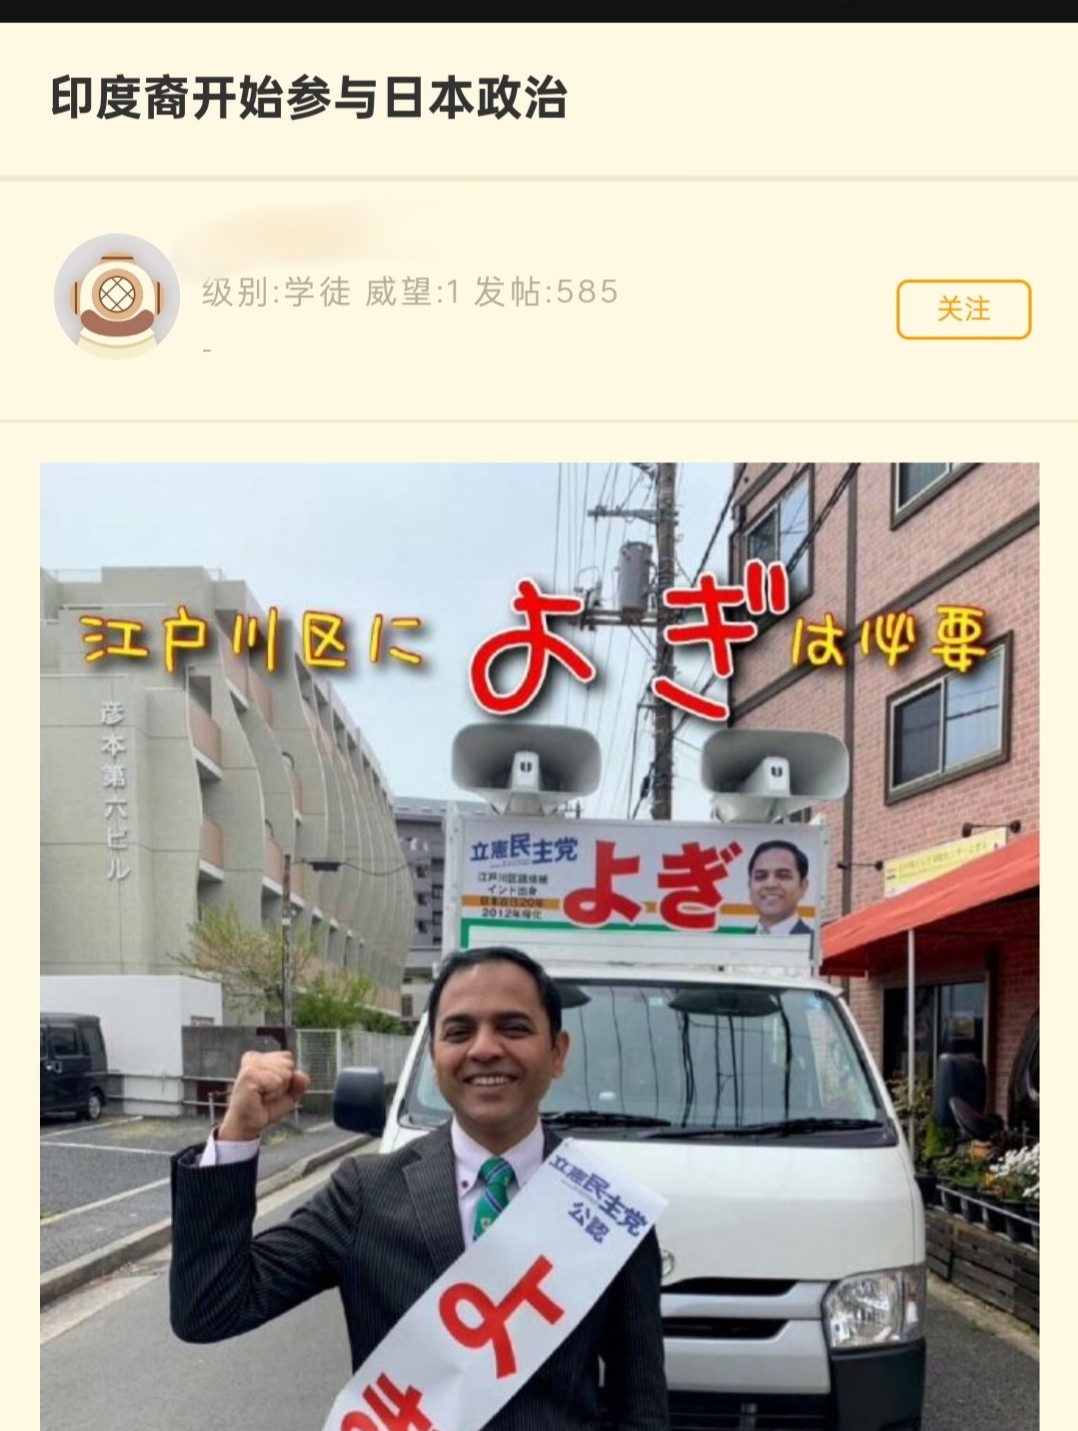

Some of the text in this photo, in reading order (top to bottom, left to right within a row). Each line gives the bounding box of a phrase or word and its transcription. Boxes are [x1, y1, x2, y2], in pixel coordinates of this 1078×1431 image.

[52, 73, 568, 121] 印度裔开始参与日本政治
[202, 276, 617, 307] 级别:学徒 威望:1 发帖:585
[938, 294, 991, 322] 关注
[470, 832, 578, 864] 立憲民主党
[563, 840, 741, 928] よぎ
[549, 1155, 648, 1238] 立憲民主党
[568, 1201, 611, 1244] 公認
